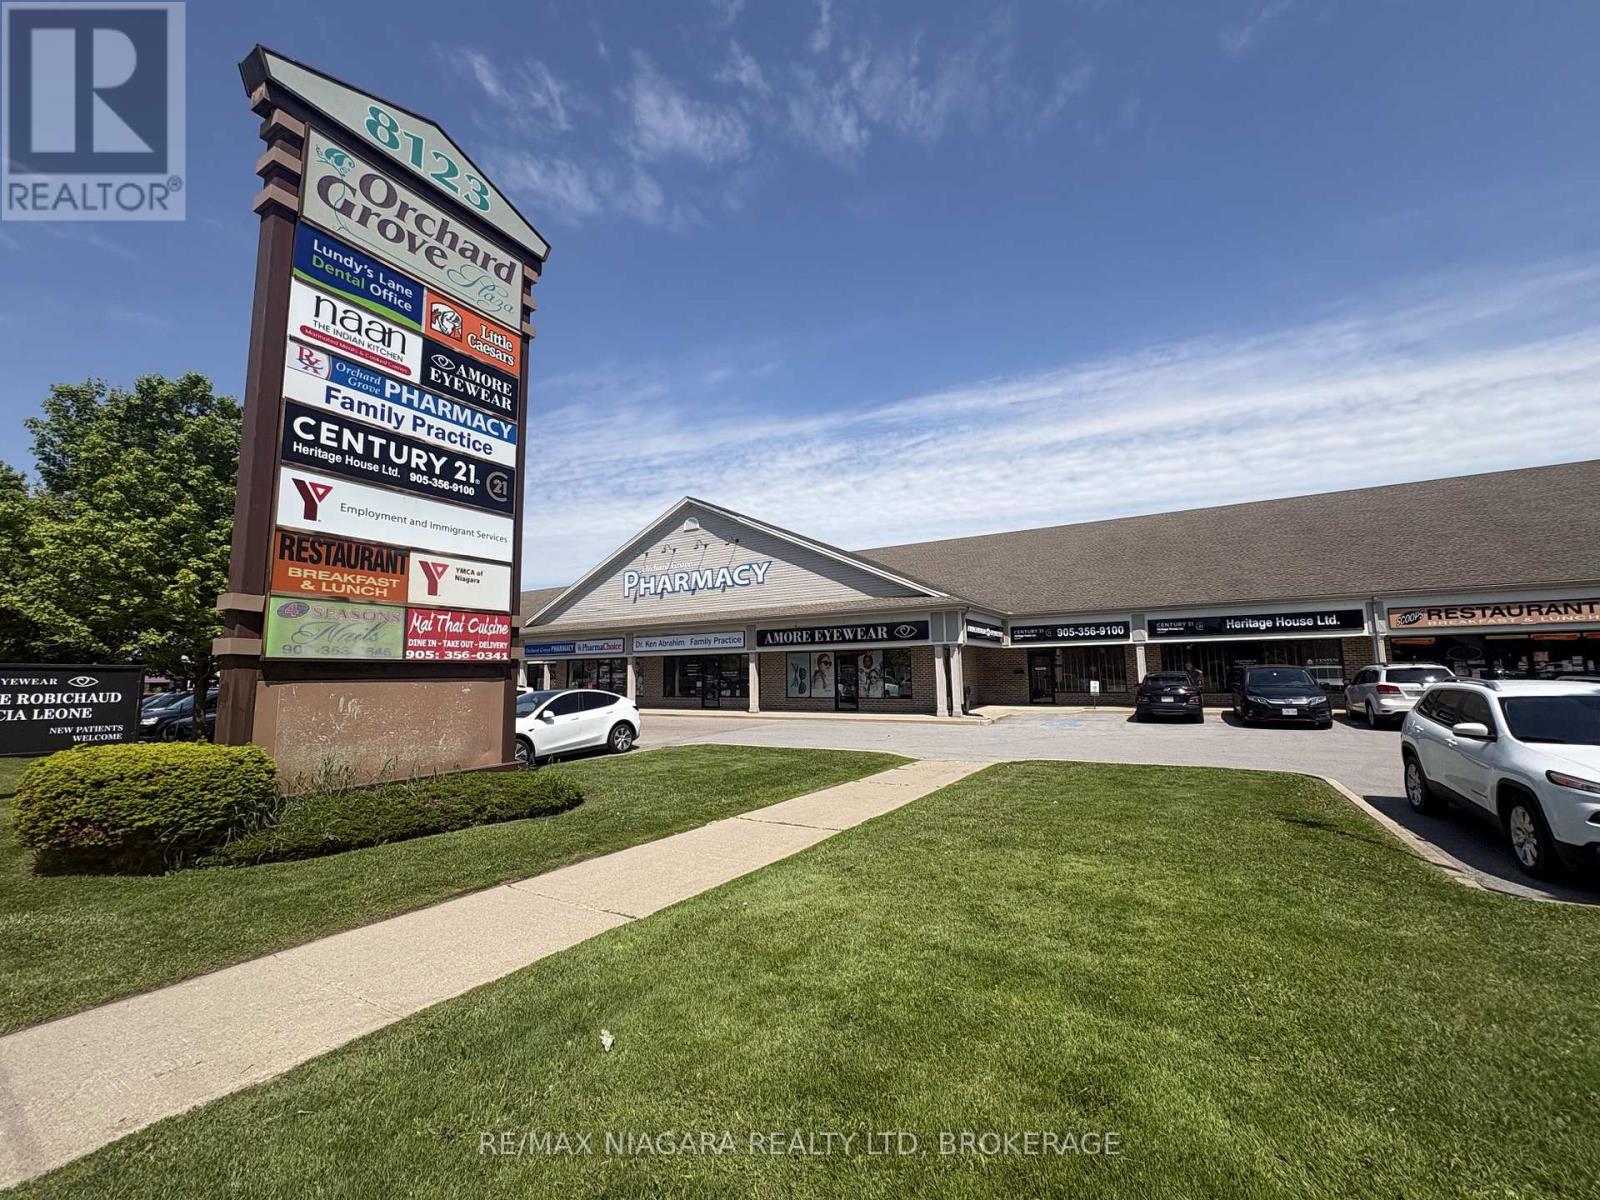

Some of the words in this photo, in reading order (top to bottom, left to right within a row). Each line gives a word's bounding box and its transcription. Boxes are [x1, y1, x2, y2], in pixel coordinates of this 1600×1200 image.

[365, 105, 491, 212] 8123
[317, 175, 449, 270] Grove
[358, 173, 517, 285] Orchard
[313, 239, 374, 278] Lundy's
[379, 272, 414, 298] Lane
[312, 255, 365, 290] Dental
[369, 284, 412, 312] Office
[446, 264, 516, 316] Plaza
[314, 295, 406, 355] naan
[480, 323, 513, 351] Little
[313, 320, 331, 333] THE
[333, 328, 365, 347] INDIAN
[367, 343, 404, 362] KITCHEN
[466, 332, 516, 367] Caesars
[336, 362, 381, 385] Orchard
[347, 376, 381, 395] Grove
[455, 364, 512, 397] AMORE
[429, 367, 512, 412] EYEWEAR
[324, 385, 406, 430] Family
[411, 415, 494, 456] Practice
[385, 379, 512, 439] PHARMACY
[292, 416, 448, 475] CENTURY
[292, 442, 342, 464] Heritage
[345, 454, 380, 473] House
[381, 464, 401, 478] Ltd.
[409, 472, 475, 497] 905-356-9100
[340, 502, 407, 525] Employment
[409, 517, 427, 529] and
[429, 520, 475, 539] Immigrant
[476, 529, 508, 544] Services
[279, 533, 410, 576] RESTAURANT
[287, 567, 401, 588] BREAKFAST
[454, 574, 481, 585] Niagara
[455, 567, 474, 576] YMCA
[475, 568, 484, 577] of
[623, 560, 773, 599] PHARMACY
[300, 580, 316, 591] &
[321, 582, 388, 598] LUNCH
[285, 602, 299, 617] 4
[312, 606, 402, 623] SEASONS
[408, 609, 435, 635] Mai
[436, 611, 465, 635] Thai
[468, 615, 509, 635] Cuisine
[1226, 617, 1273, 631] Heritage
[1276, 616, 1313, 628] House
[1317, 614, 1340, 626] Ltd.
[1395, 608, 1426, 626] SCOOPS
[1427, 601, 1599, 620] RESTAURANT
[1428, 617, 1516, 626] BREAKFAST
[1540, 614, 1600, 622] LUNCH
[291, 619, 388, 645] Nails
[408, 639, 427, 647] DINE
[442, 640, 460, 648] TAKE
[460, 640, 474, 648] OUT
[479, 641, 508, 649] DELIVERY
[635, 639, 644, 648] Dr.
[645, 639, 657, 647] Ken
[658, 637, 685, 647] Abrahim
[689, 637, 711, 647] Family
[713, 635, 742, 645] Practice
[764, 629, 811, 644] AMORE
[814, 626, 889, 642] EYEWEAR
[1057, 625, 1125, 637] 905-356-9100
[406, 650, 439, 659] 905:
[444, 651, 508, 660] 356-0341
[16, 692, 122, 705] ROBICHAUD
[31, 707, 93, 720] LEONE
[49, 726, 73, 734] NEW
[76, 724, 124, 734] PATIENTS
[72, 733, 123, 742] WELCOME
